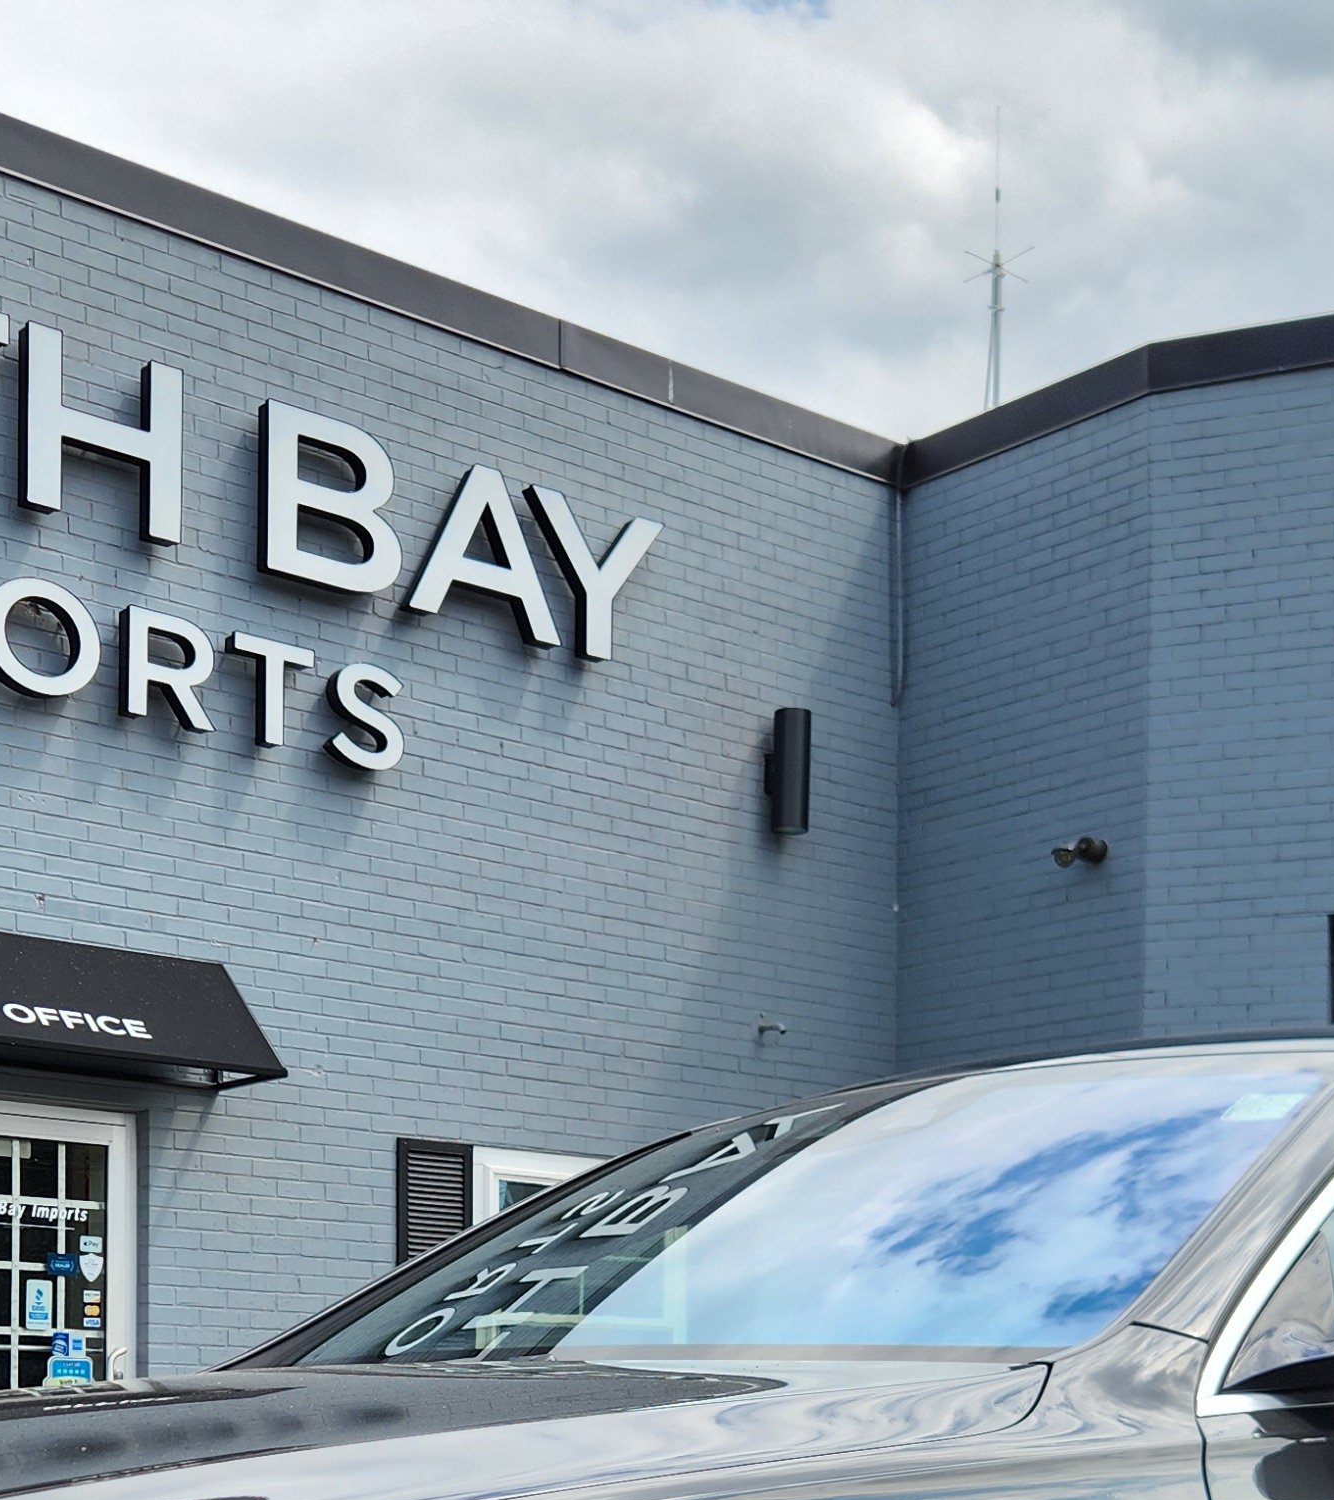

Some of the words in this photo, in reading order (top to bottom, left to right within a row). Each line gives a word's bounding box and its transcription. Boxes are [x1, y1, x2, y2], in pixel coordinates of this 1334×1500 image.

[257, 399, 663, 663] BAY
[2, 1003, 153, 1040] OFFICE
[31, 1204, 89, 1222] Imports
